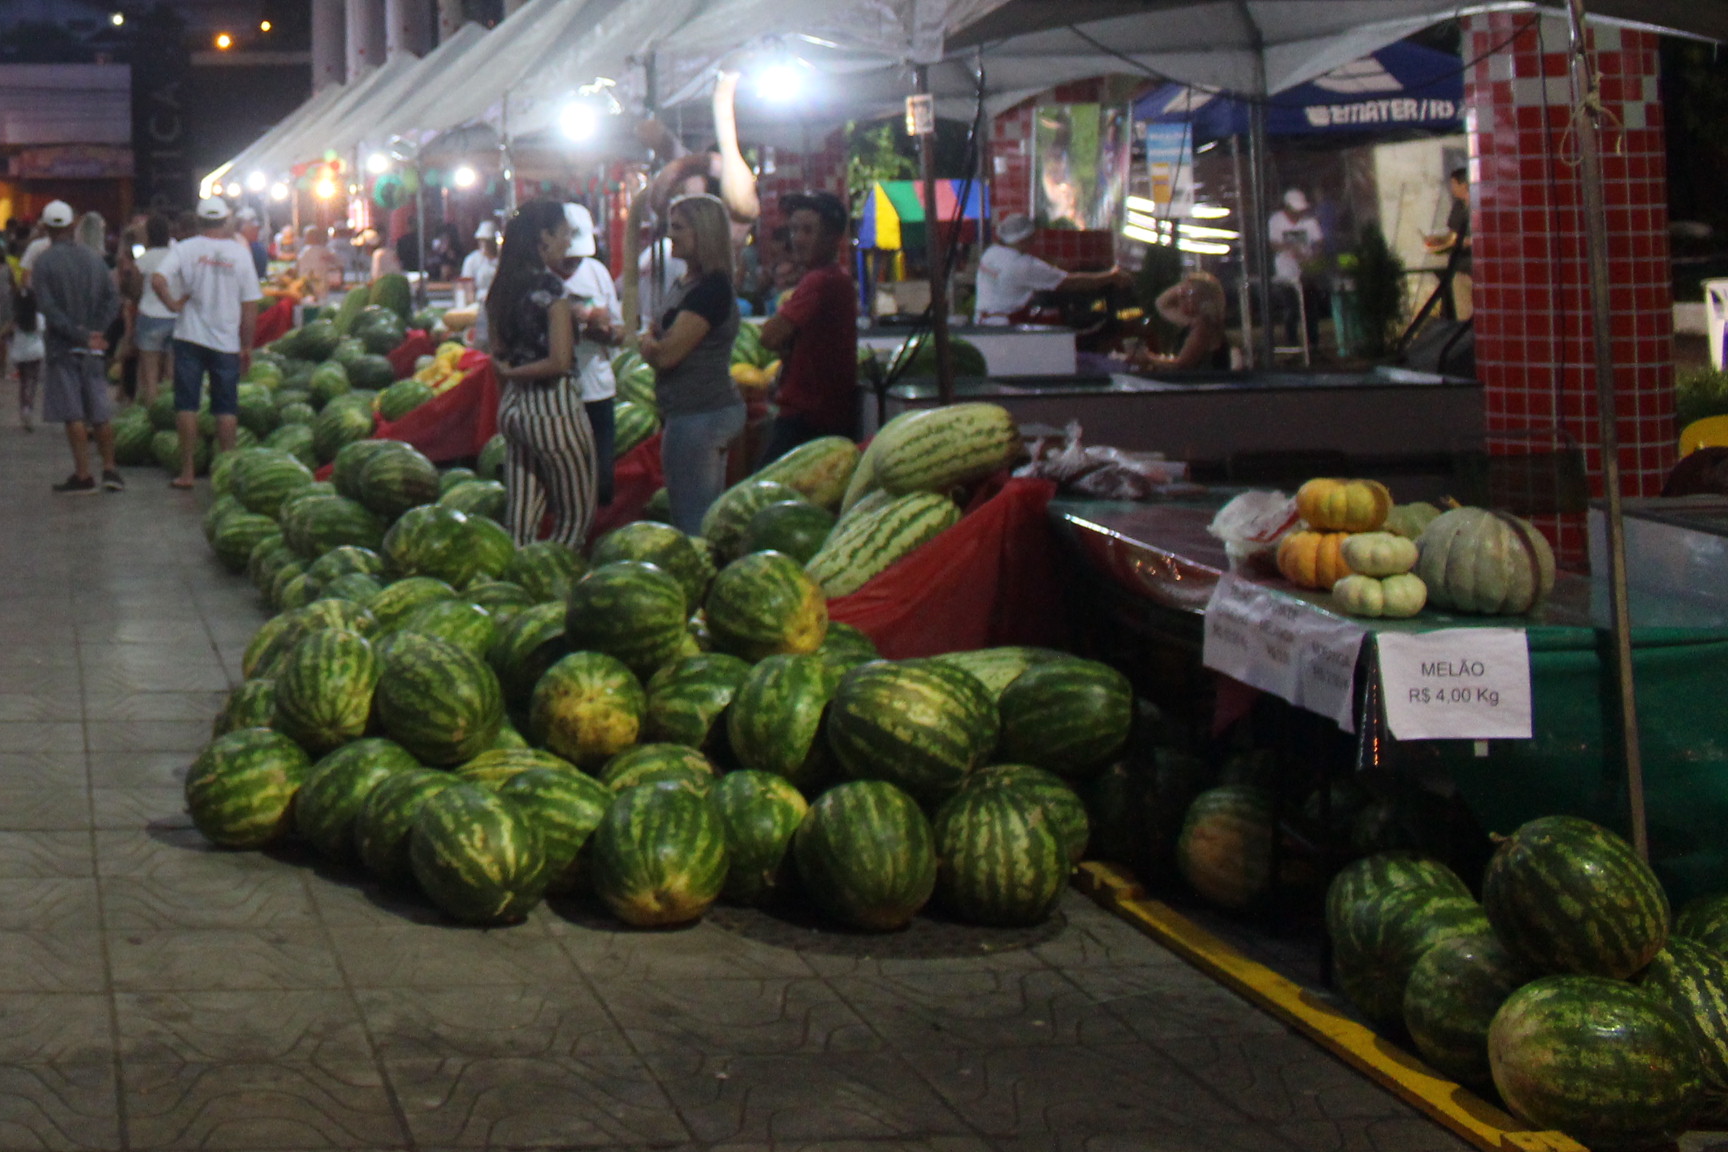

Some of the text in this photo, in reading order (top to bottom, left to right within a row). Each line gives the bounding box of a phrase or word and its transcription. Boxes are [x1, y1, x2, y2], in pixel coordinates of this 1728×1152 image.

[1421, 659, 1485, 677] MELÃO
[1409, 688, 1500, 707] R$ 4,00 Kg
